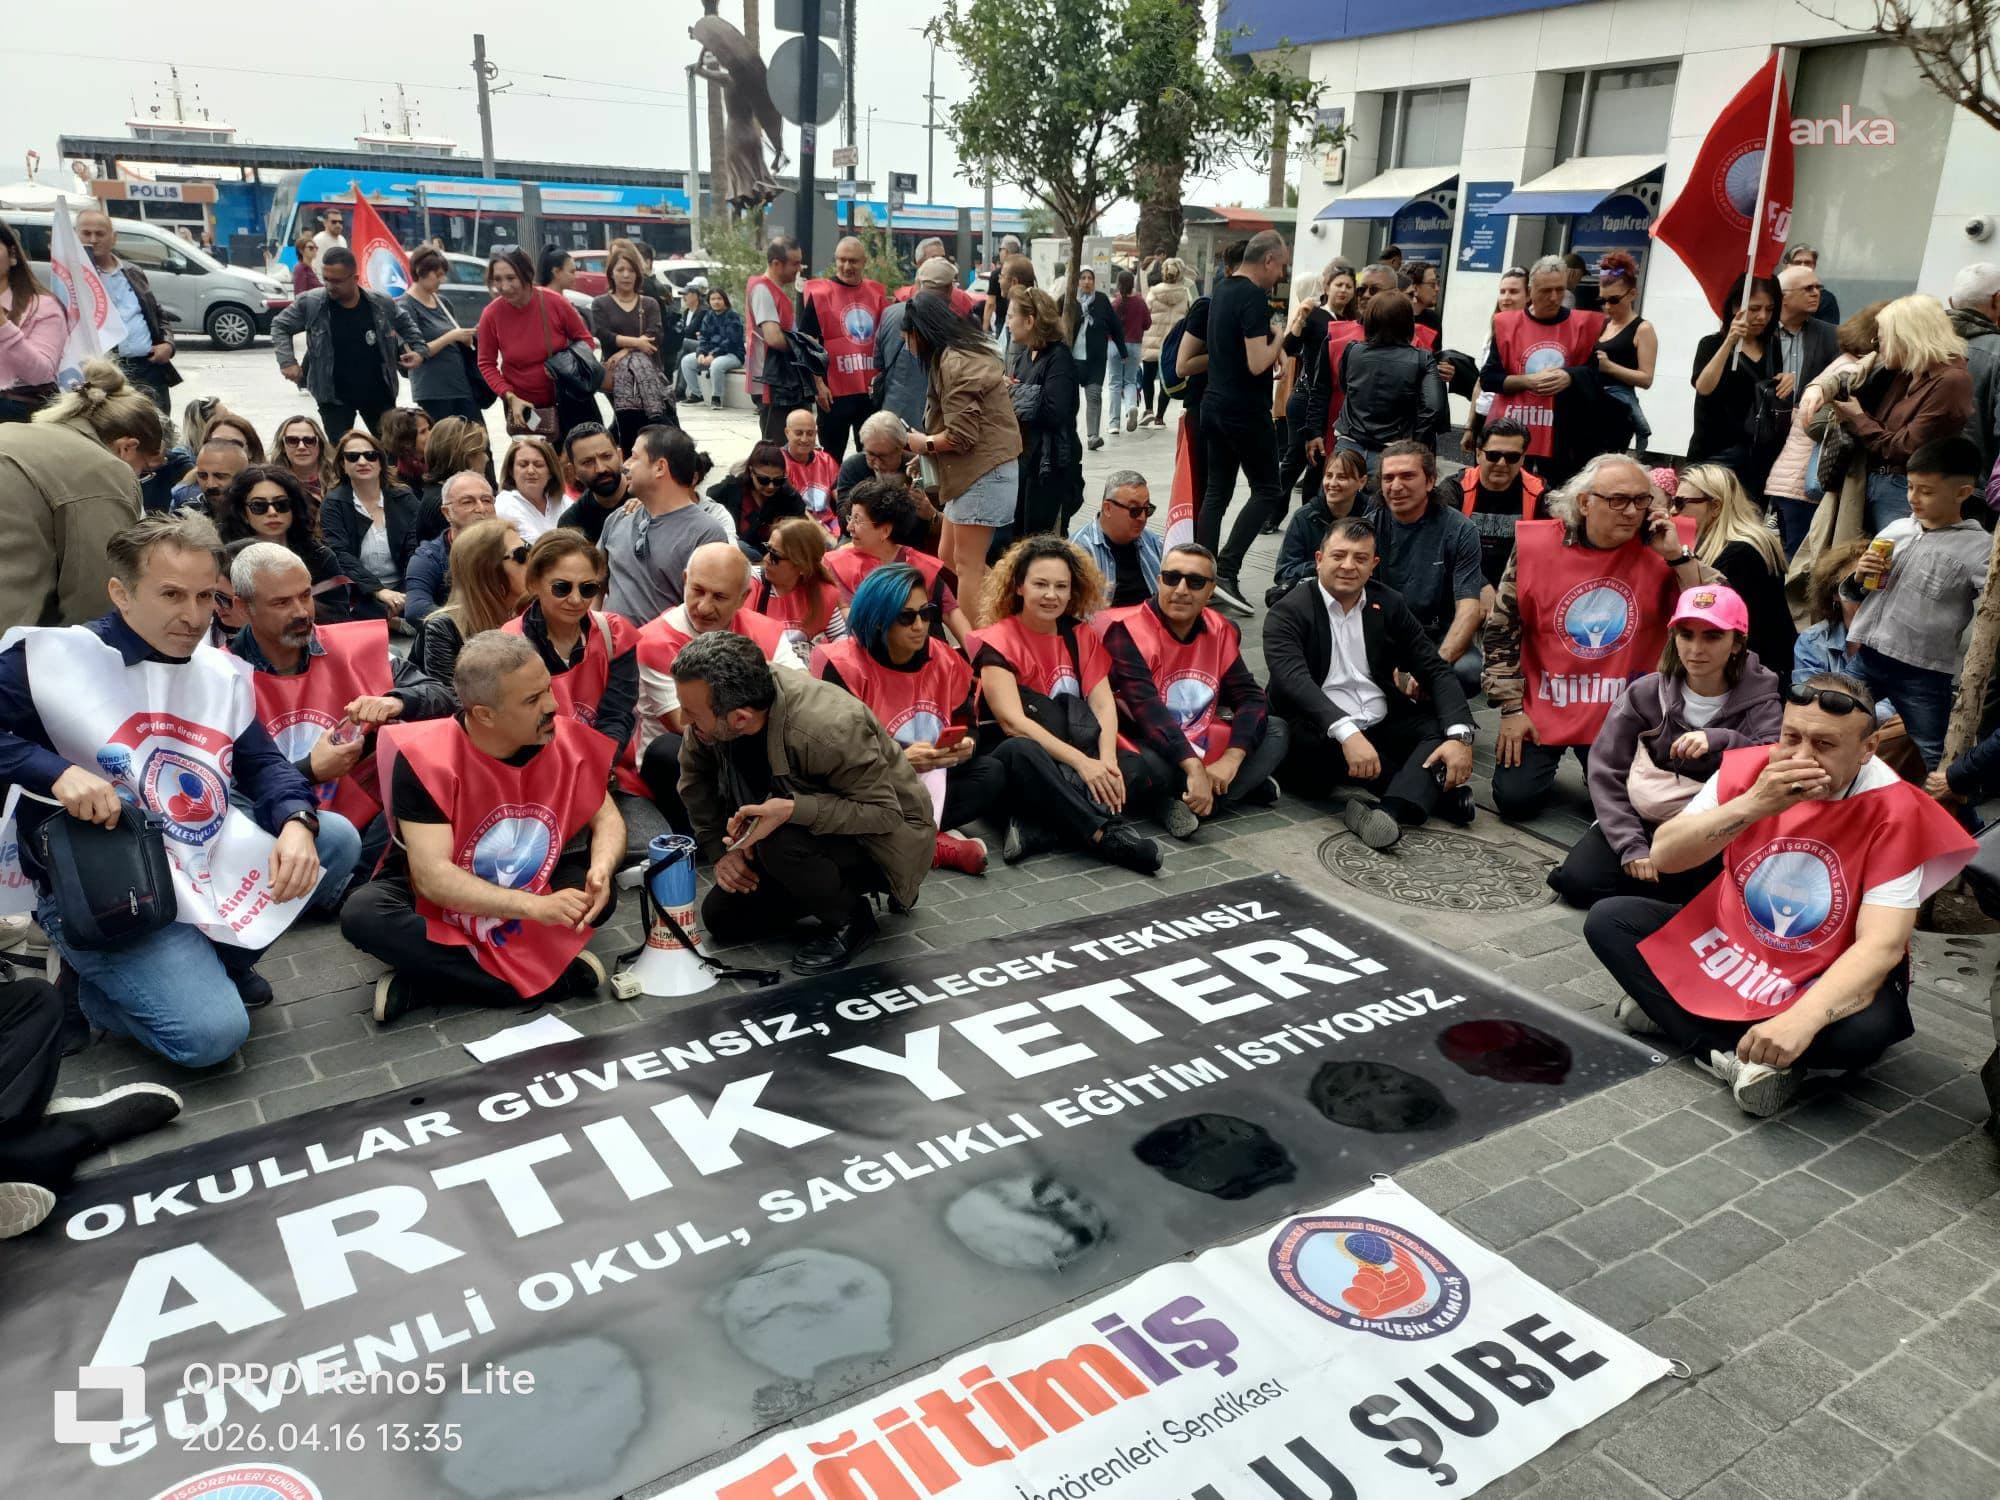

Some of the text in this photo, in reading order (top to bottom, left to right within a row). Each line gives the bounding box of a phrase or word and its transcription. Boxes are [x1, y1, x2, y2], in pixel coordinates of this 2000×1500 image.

[65, 900, 1282, 1242] OKULLAR GÜVENSİZ, GELECEK TEKİNSİZ
[88, 926, 1389, 1368] ARTIK YETER!
[89, 986, 1467, 1467] GÜVENLİ OKUL, SAĞLIKLI EĞİTİM İSTİYORUZ.
[1349, 1275, 1463, 1339] BİRLEŞİK KAMU-İŞ
[1163, 1377, 1289, 1445] Sendikası
[1348, 1313, 1610, 1487] ŞUBE
